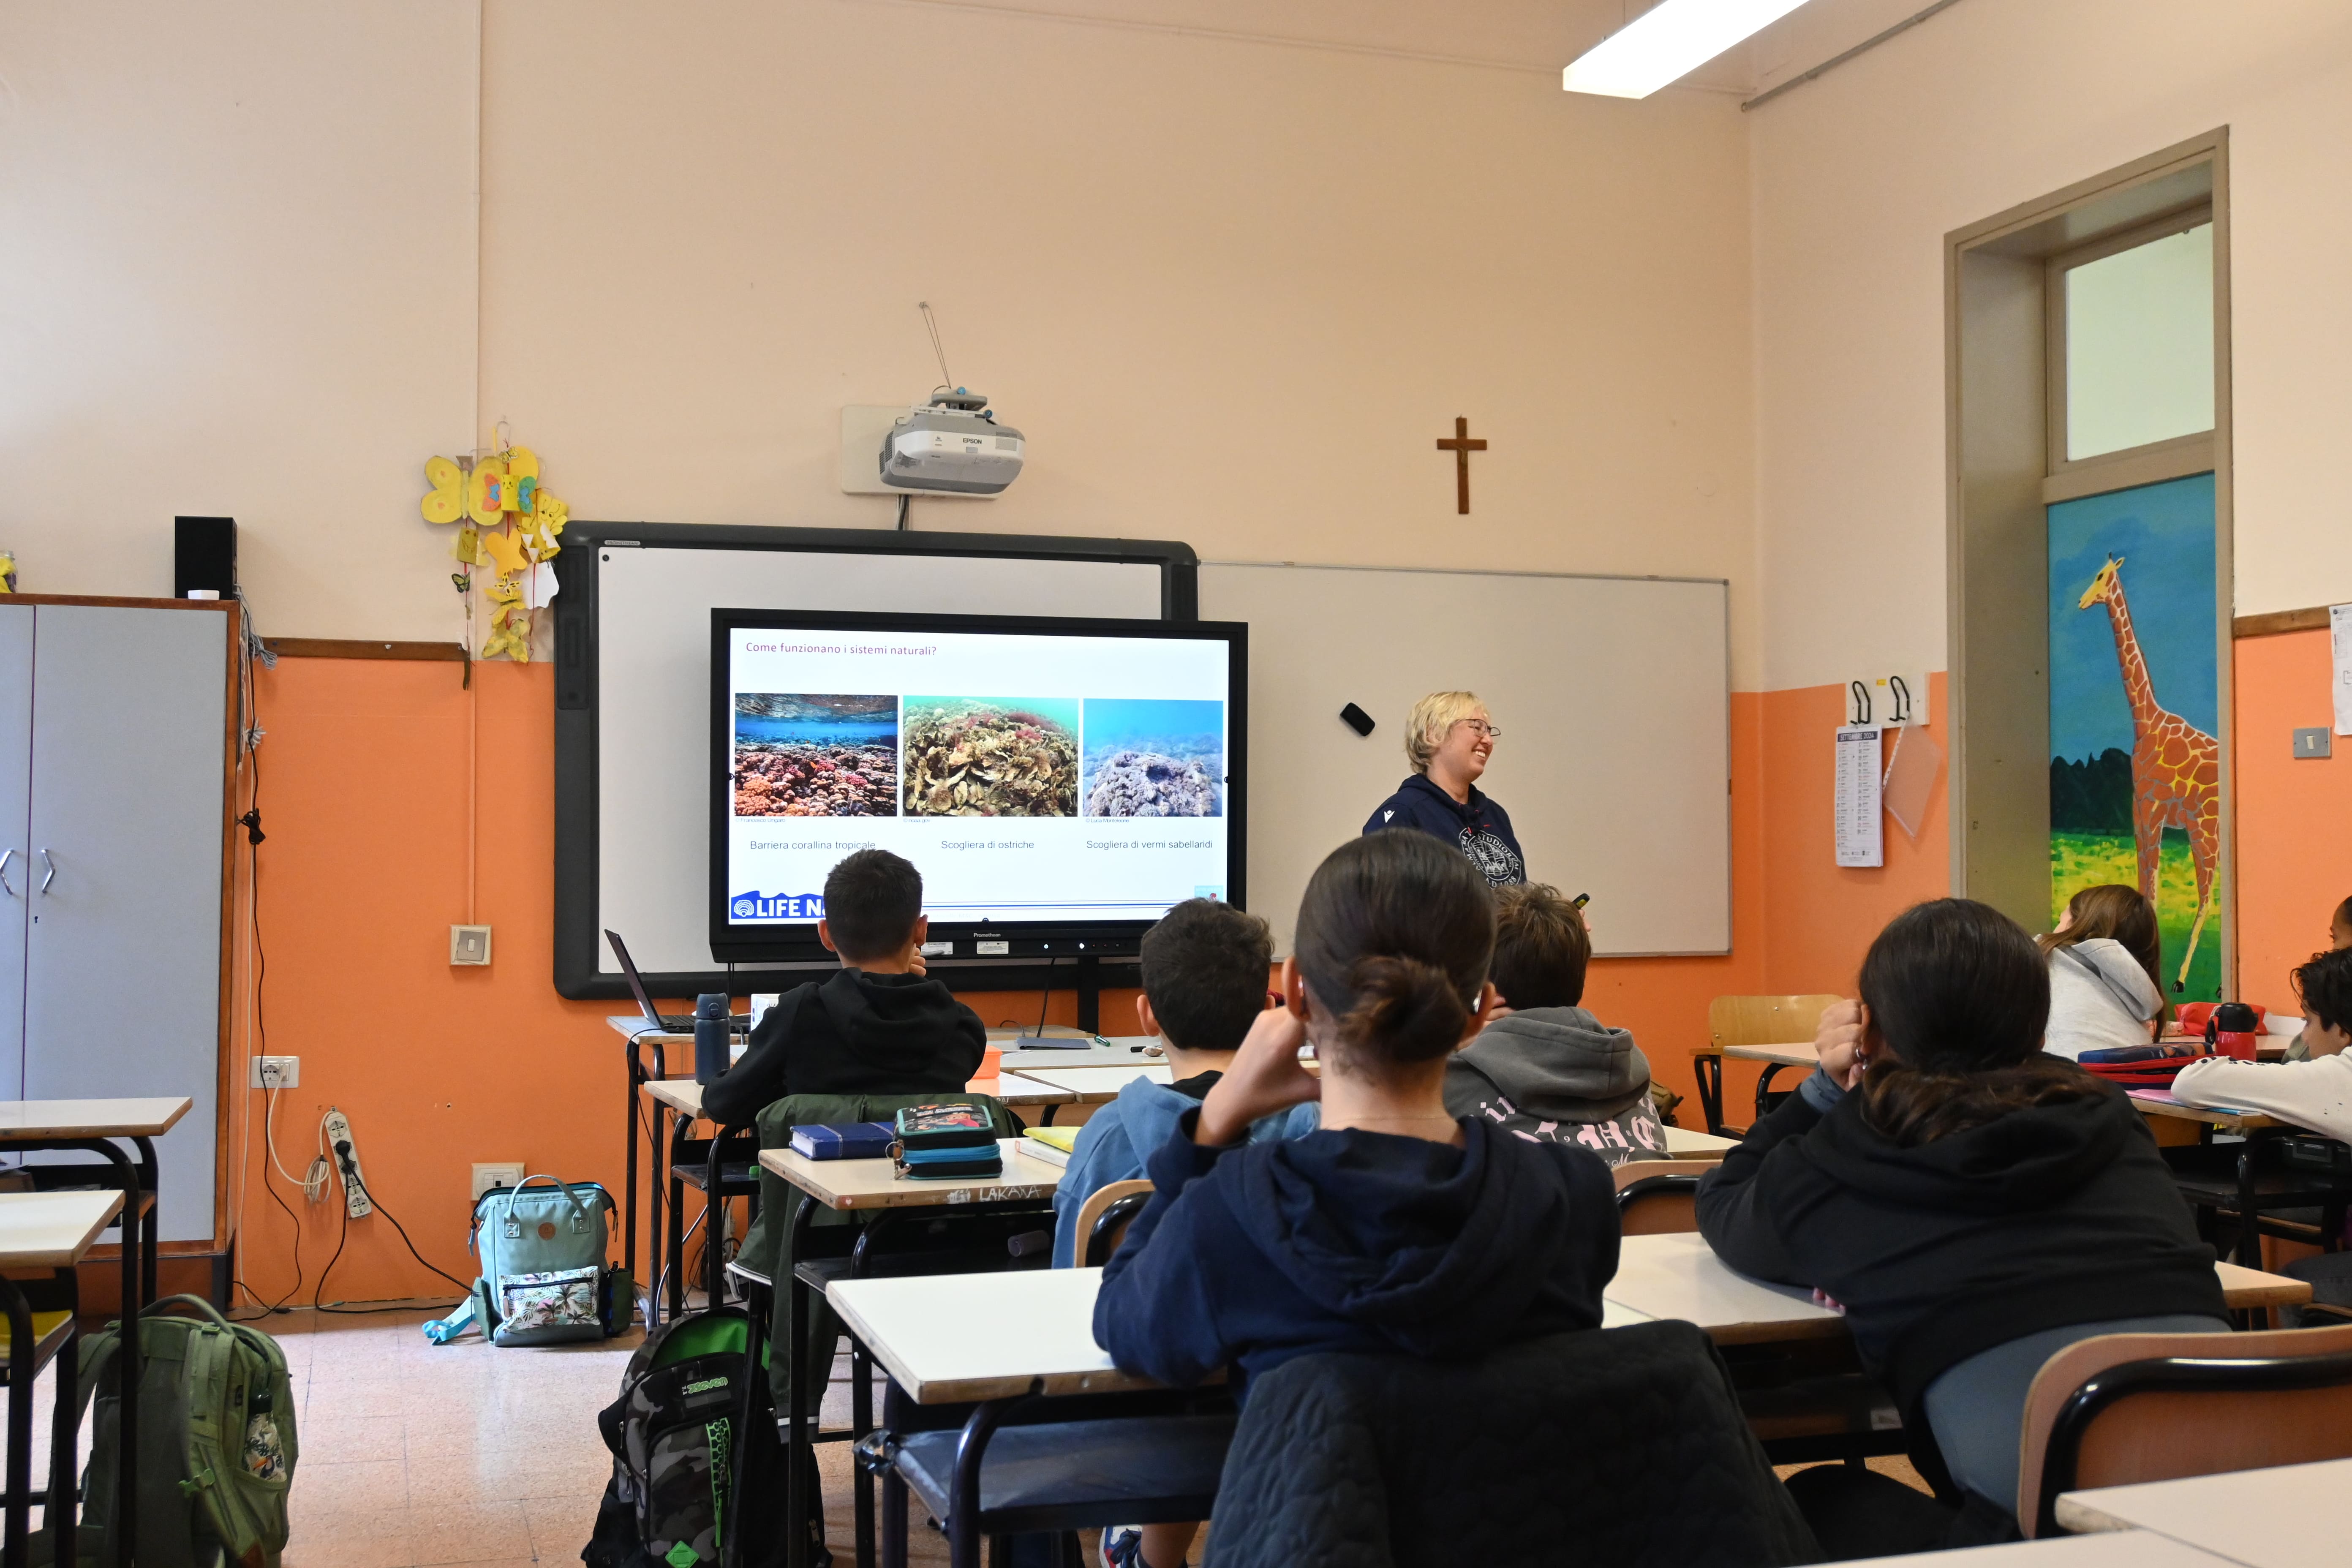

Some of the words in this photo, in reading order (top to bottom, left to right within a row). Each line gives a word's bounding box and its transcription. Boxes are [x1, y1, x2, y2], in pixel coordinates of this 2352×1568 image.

[746, 642, 777, 652] Come
[780, 642, 841, 653] funzionano
[844, 644, 847, 653] i
[850, 645, 887, 654] sistemi
[890, 646, 936, 655] naturali?
[750, 841, 789, 849] Barriera
[792, 841, 832, 849] corallina
[836, 841, 876, 851] tropicale
[941, 841, 984, 851] Scogliera
[987, 841, 995, 849] di
[998, 841, 1034, 849] ostriche
[1086, 841, 1128, 851] Scogliera
[757, 899, 800, 917] LIFE
